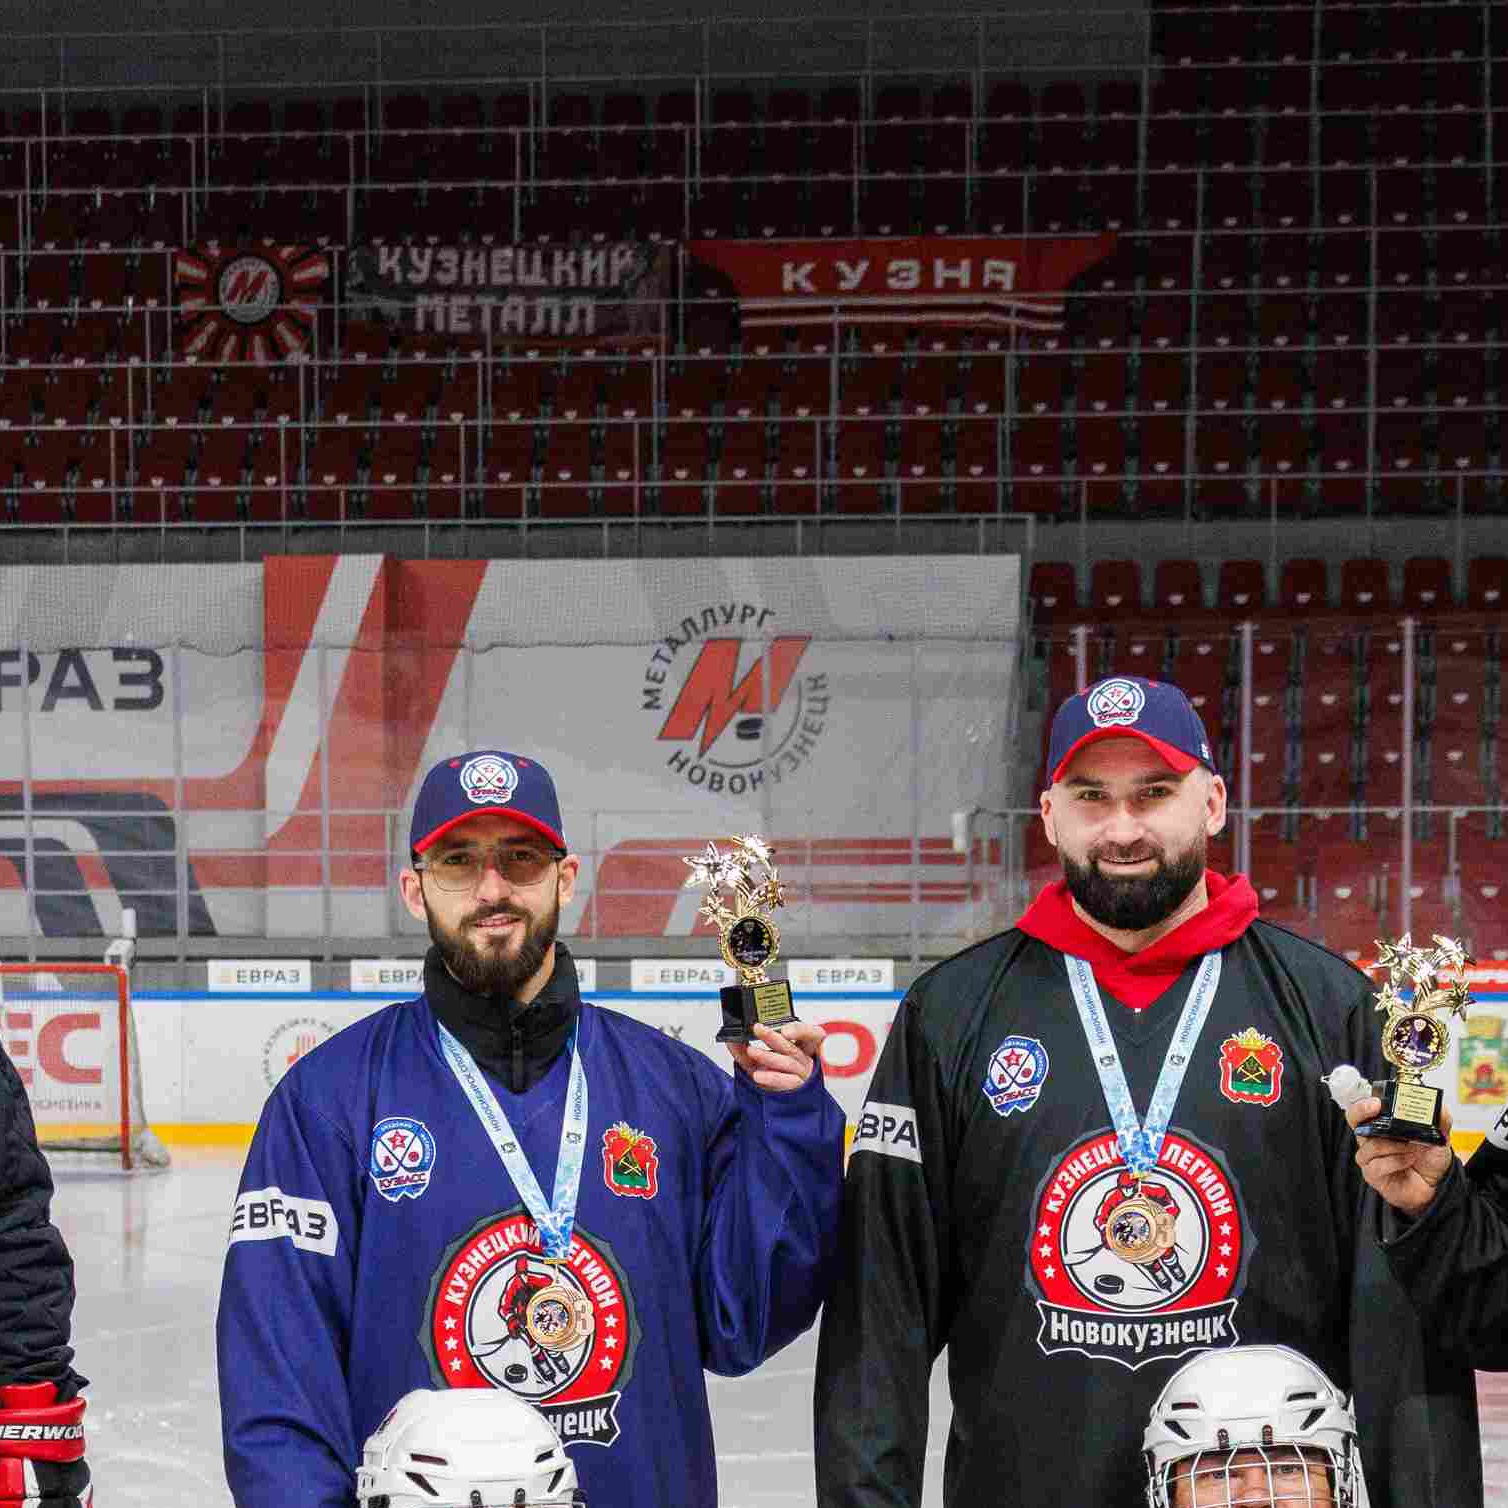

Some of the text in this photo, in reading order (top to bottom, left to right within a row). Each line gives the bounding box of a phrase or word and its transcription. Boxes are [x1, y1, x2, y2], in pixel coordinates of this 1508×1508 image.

[782, 258, 1017, 292] КУЗНЯ
[642, 603, 777, 711] МЕТАЛЛУРГ
[236, 968, 301, 984] ЕВРАЗ
[659, 968, 726, 984] ЕВРАЗ
[816, 968, 883, 984] ЕВРАЗ
[1164, 1142, 1233, 1218] ЛЕГИОН
[567, 1241, 620, 1310] ЕГИОН
